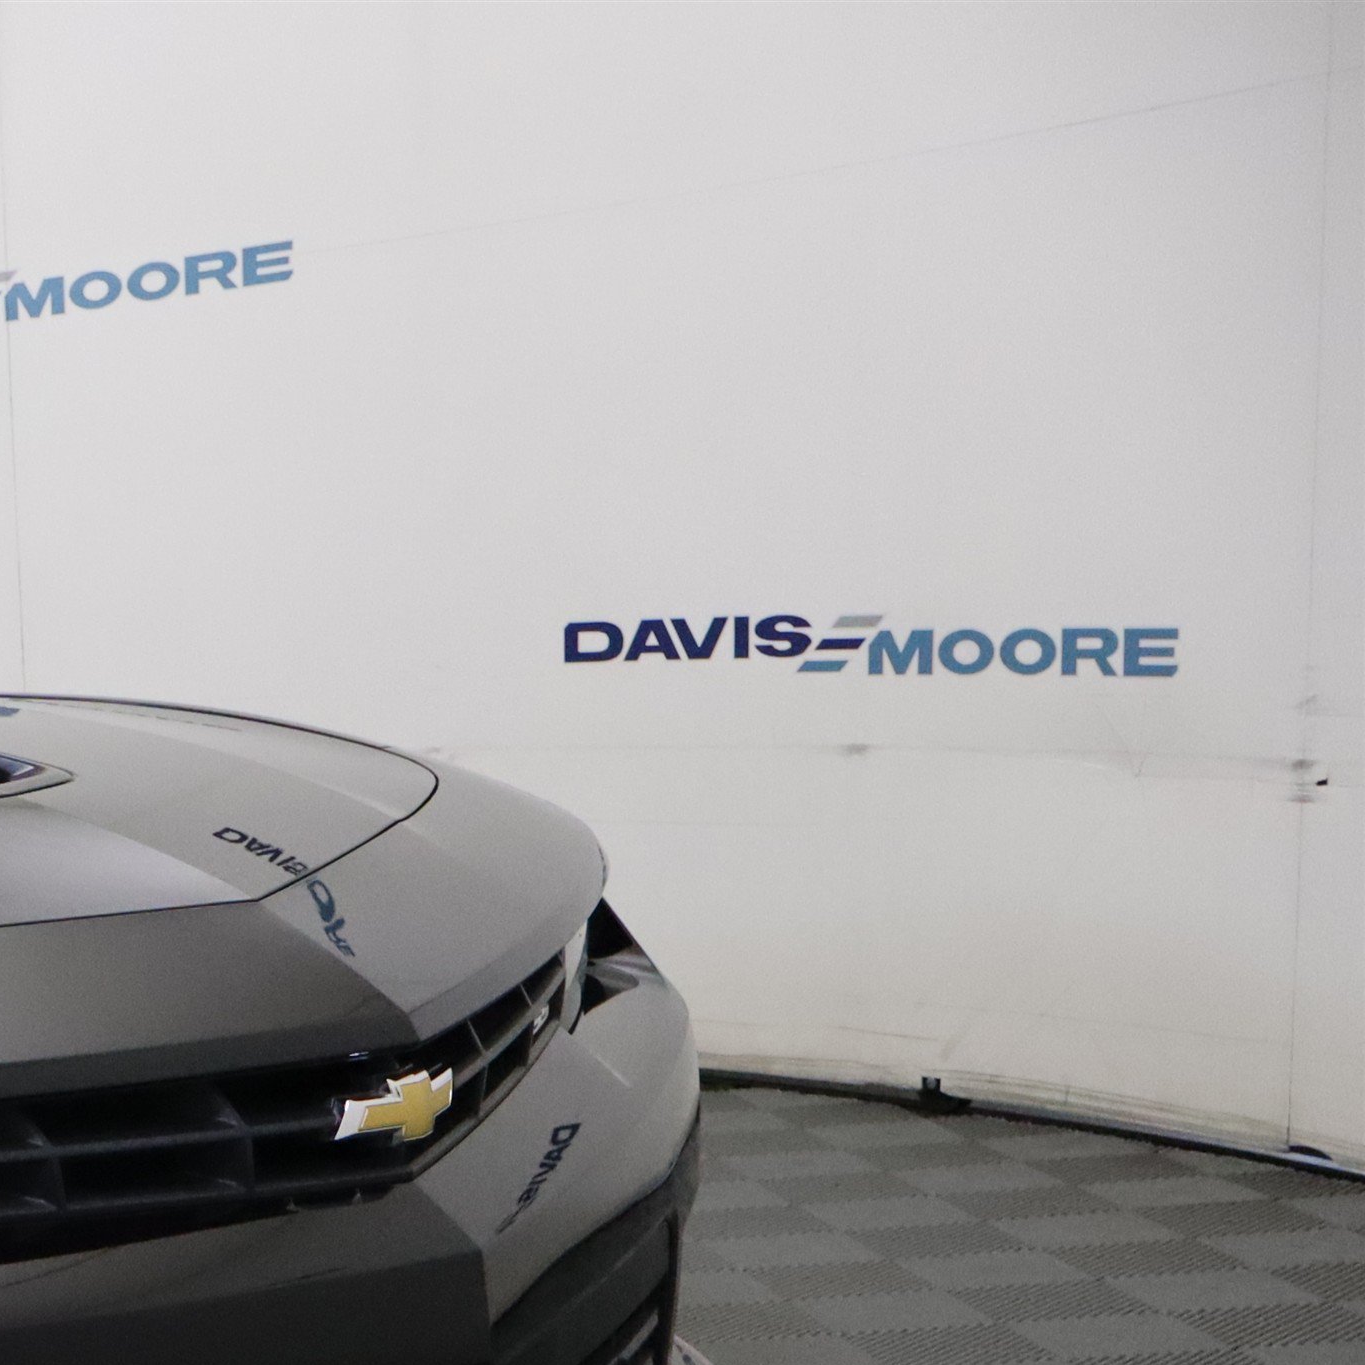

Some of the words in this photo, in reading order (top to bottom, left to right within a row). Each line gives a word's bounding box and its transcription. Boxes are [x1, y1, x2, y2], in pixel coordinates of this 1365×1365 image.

[4, 240, 294, 322] MOORE
[563, 614, 812, 663] DAVIS
[866, 628, 1180, 678] MOORE
